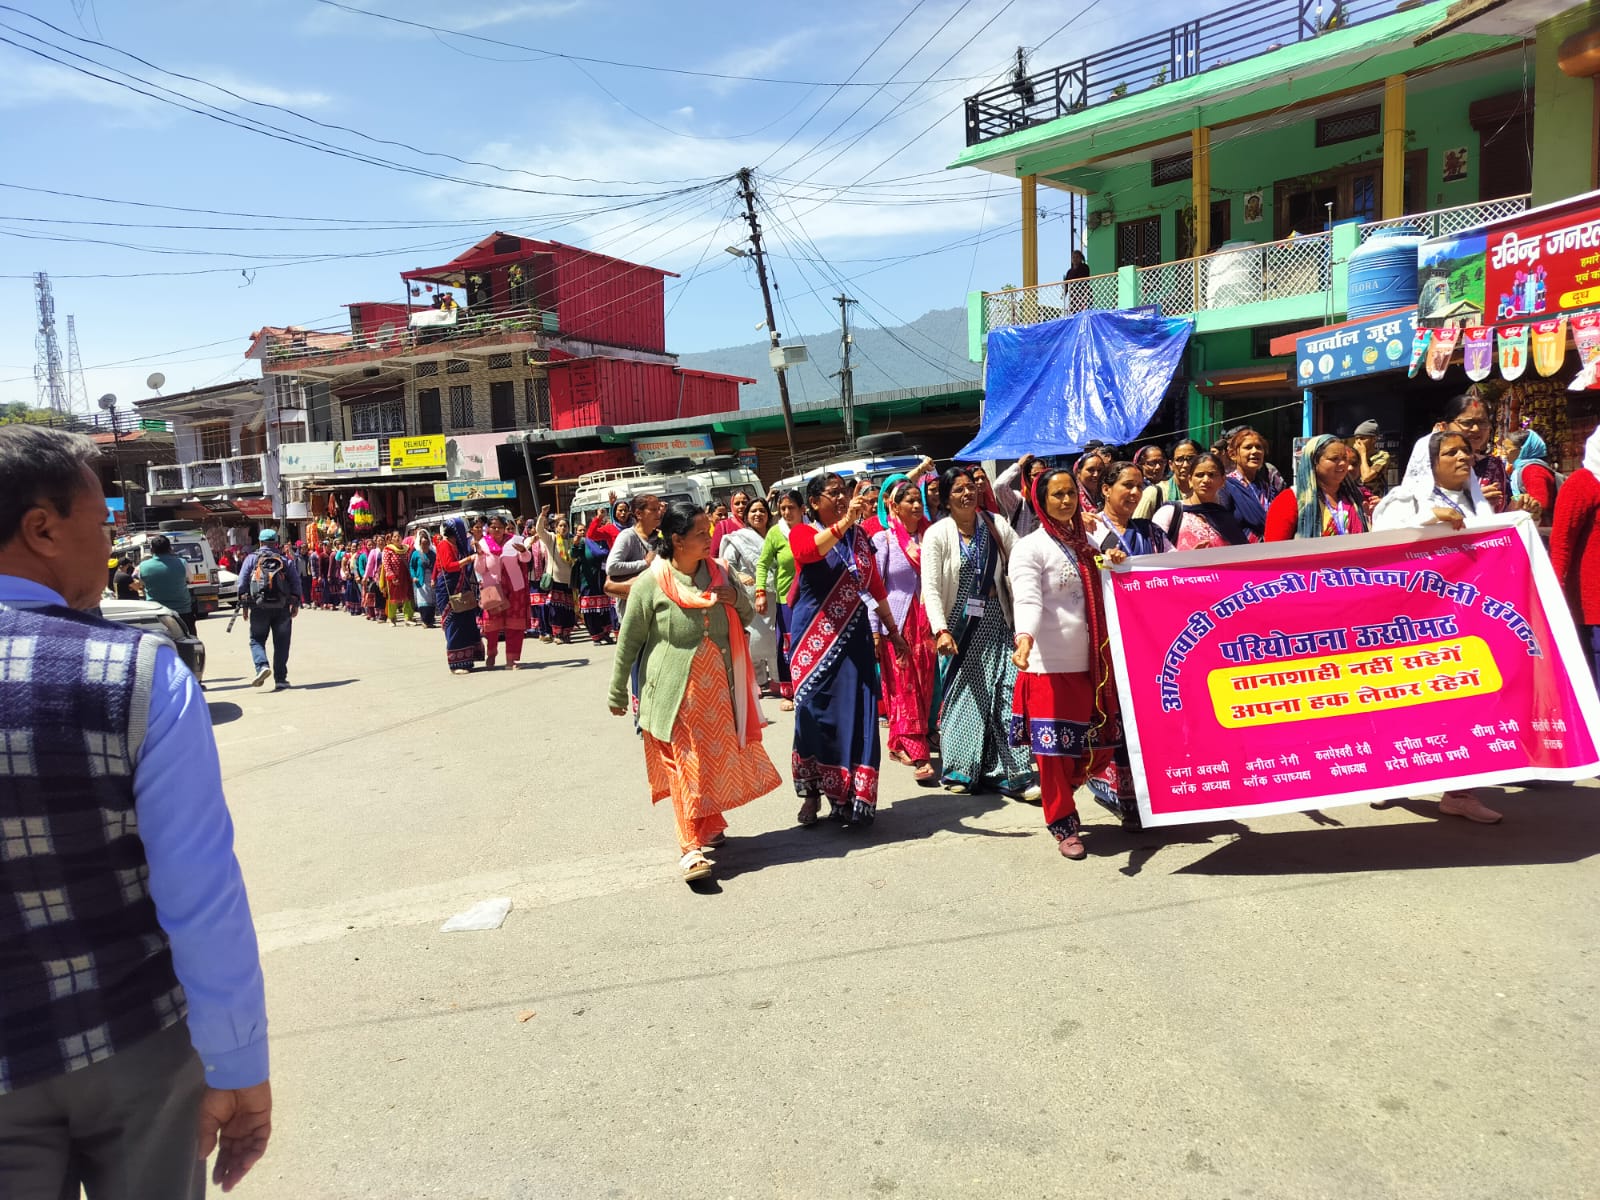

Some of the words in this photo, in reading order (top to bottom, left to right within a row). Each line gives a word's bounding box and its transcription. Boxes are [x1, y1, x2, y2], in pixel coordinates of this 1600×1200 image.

[1491, 232, 1543, 270] रविन्द्र
[1365, 320, 1402, 343] जूस
[1144, 577, 1169, 589] शक्ति
[1219, 629, 1348, 662] परियोजना
[1353, 615, 1459, 648] ऊखीमठ
[1231, 663, 1339, 690] तानाशाही
[1349, 656, 1393, 677] नहीं
[1230, 698, 1301, 720] अपना
[1307, 692, 1349, 710] हक
[1356, 685, 1421, 704] लेकर
[1470, 723, 1496, 738] सीमा
[1498, 719, 1521, 734] नेगी
[1355, 741, 1373, 756] देवी
[1393, 738, 1423, 755] सुनीता
[1487, 738, 1517, 753] सचिव
[1245, 757, 1276, 772] अनीता
[1280, 753, 1300, 768] नेगी
[1329, 760, 1368, 778] कोषाध्यक्ष
[1385, 756, 1409, 771] प्रदेश
[1411, 749, 1443, 767] मीडिया
[1164, 765, 1193, 780] रंजना
[1196, 760, 1230, 776] अवस्थी
[1242, 774, 1269, 788] ब्लॉक
[1272, 769, 1312, 785] उपाध्यक्ष
[1169, 780, 1198, 796] ब्लॉक
[1200, 778, 1231, 793] अध्यक्ष
